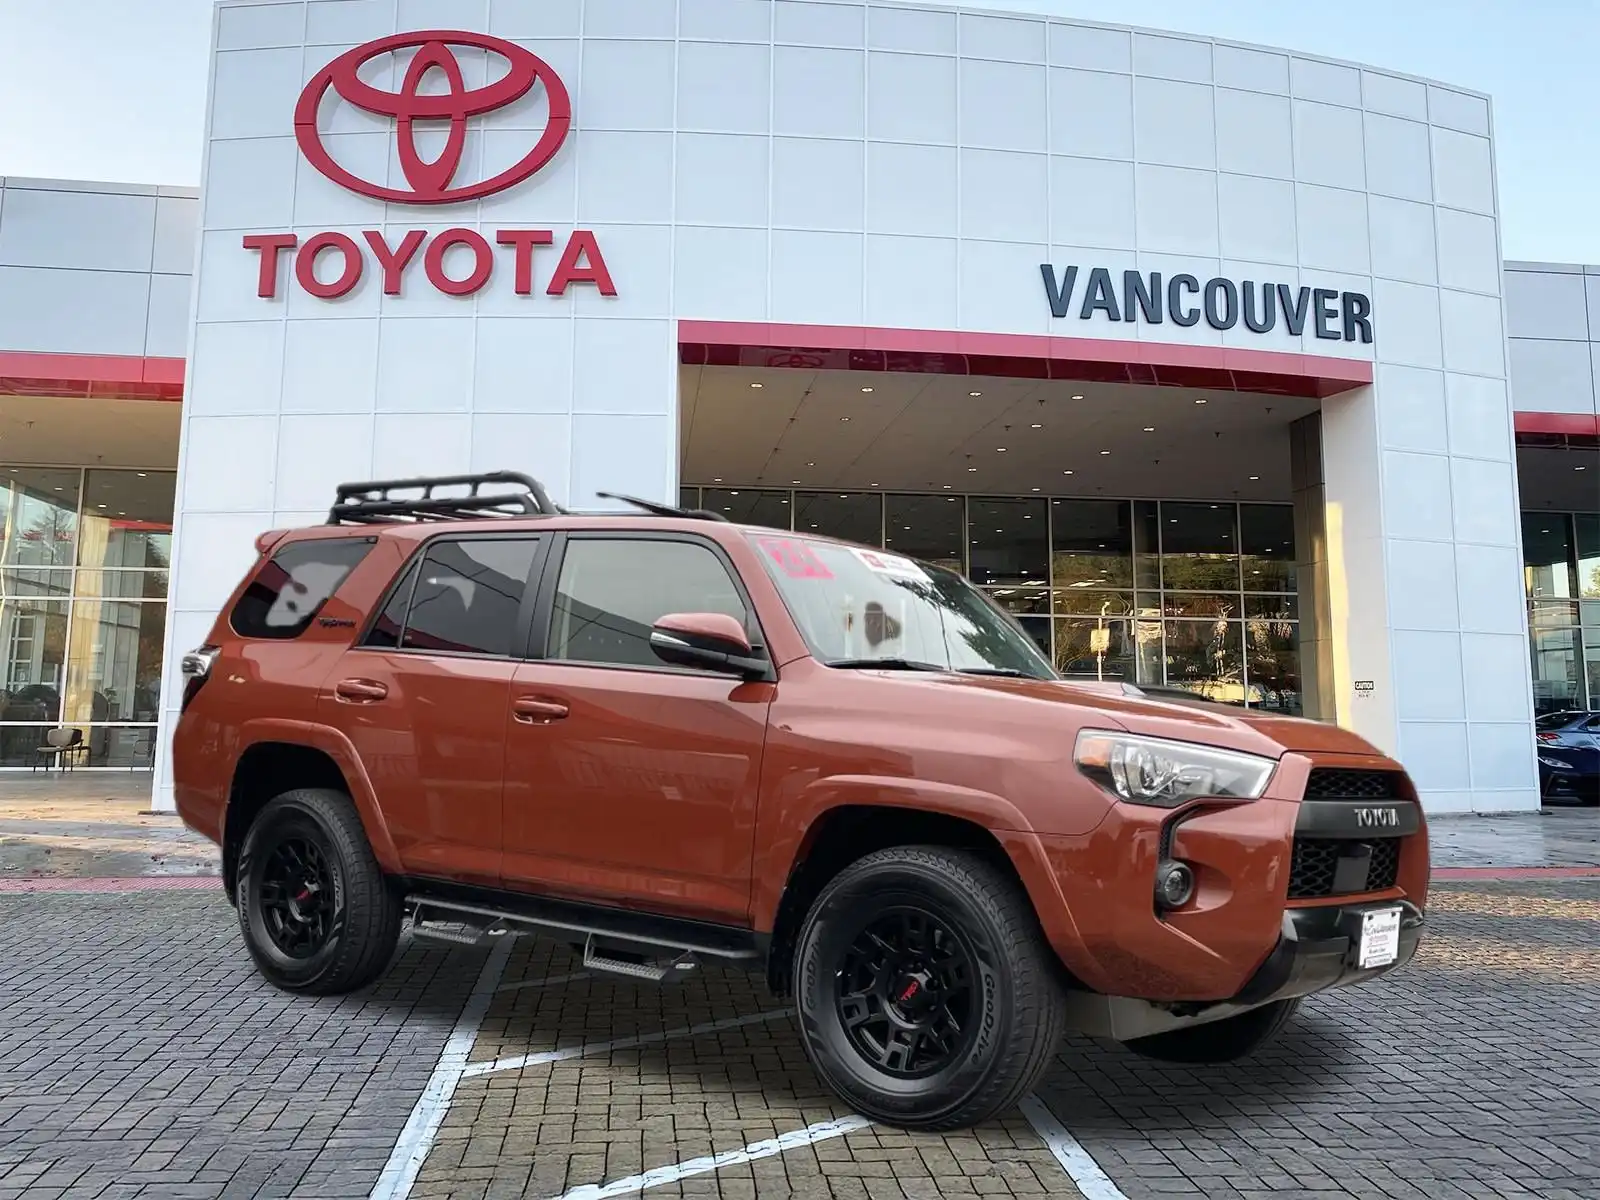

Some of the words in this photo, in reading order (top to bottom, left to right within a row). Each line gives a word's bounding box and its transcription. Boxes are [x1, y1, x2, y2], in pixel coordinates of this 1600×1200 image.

[243, 228, 618, 298] TOYOTA
[1040, 264, 1373, 343] VANCOUVER
[1353, 808, 1400, 827] TOYOTA
